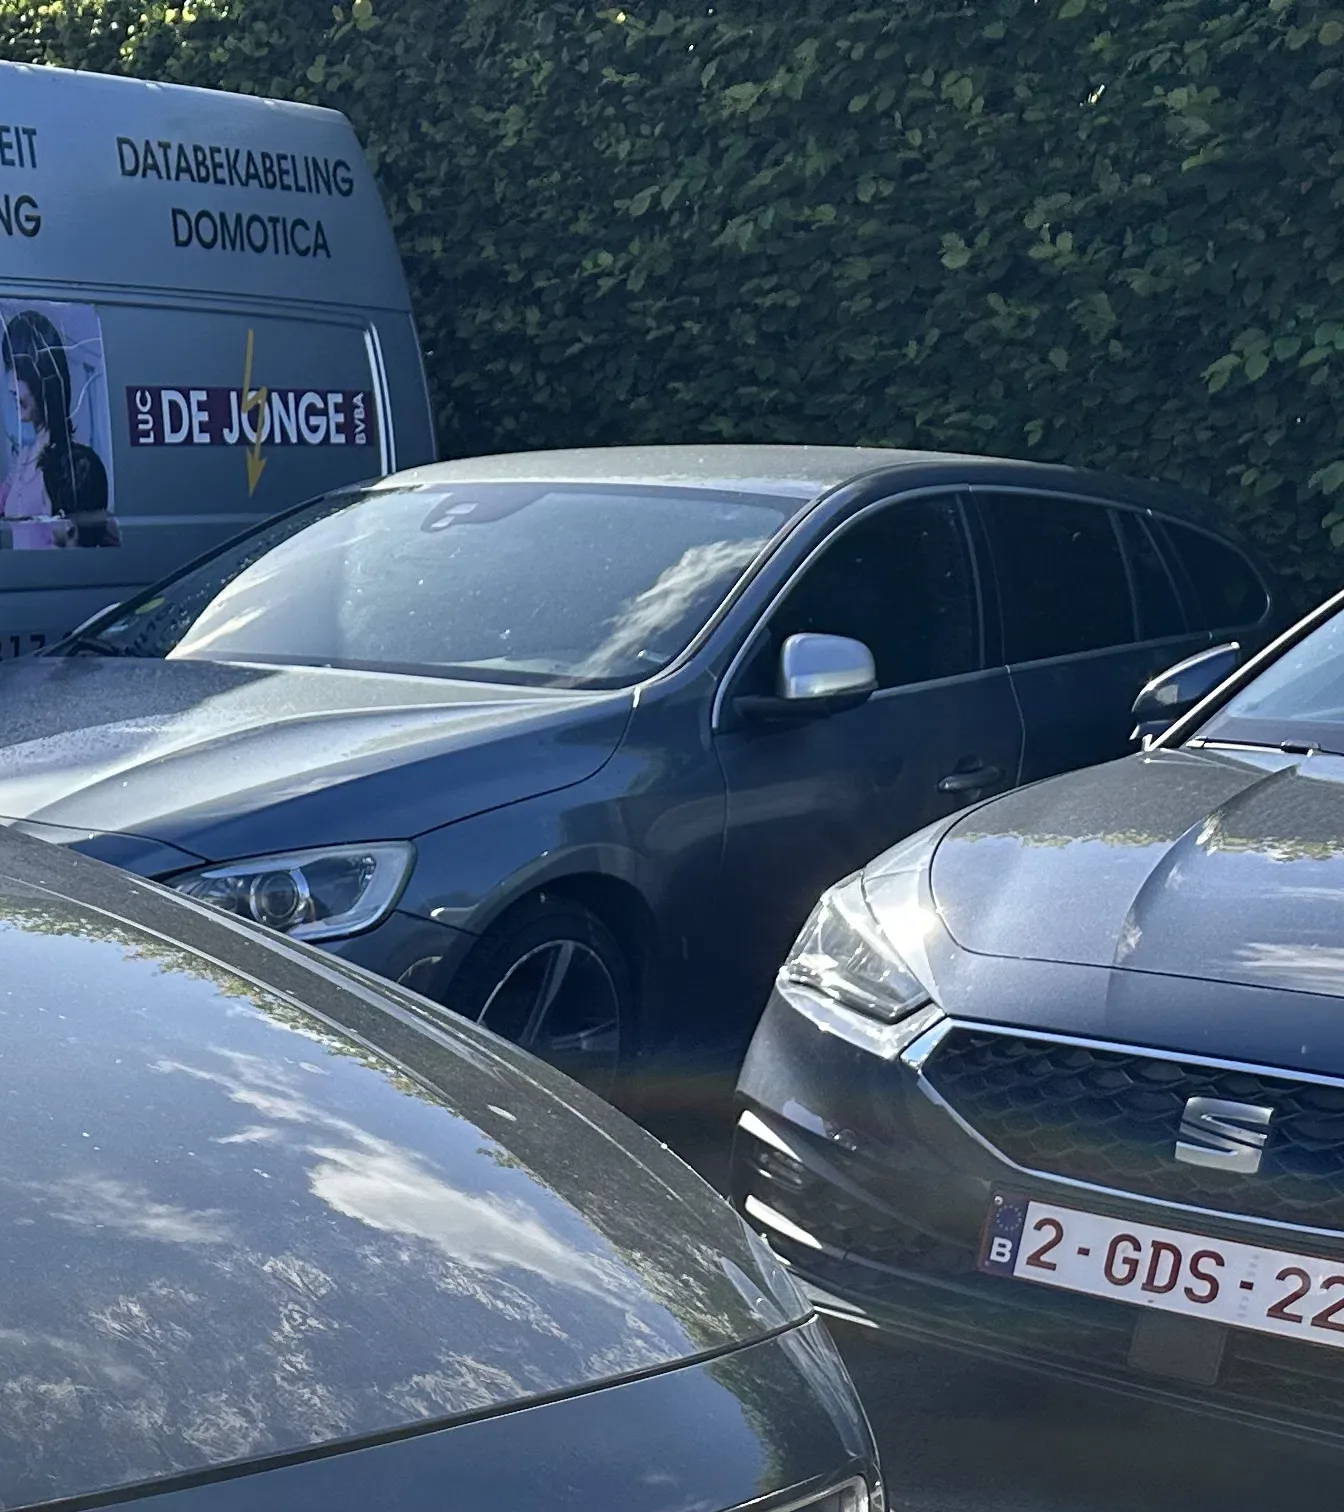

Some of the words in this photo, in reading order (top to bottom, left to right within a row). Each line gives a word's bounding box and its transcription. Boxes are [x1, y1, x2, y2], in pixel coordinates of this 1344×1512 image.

[115, 136, 354, 197] DATABEKABELING
[171, 207, 332, 259] DOMOTICA
[135, 389, 155, 444] LUC
[161, 389, 211, 444] DE
[223, 390, 346, 445] JONGE
[352, 392, 366, 445] BVBA
[989, 1237, 1012, 1263] B
[1025, 1217, 1344, 1332] 2-GDS-22
